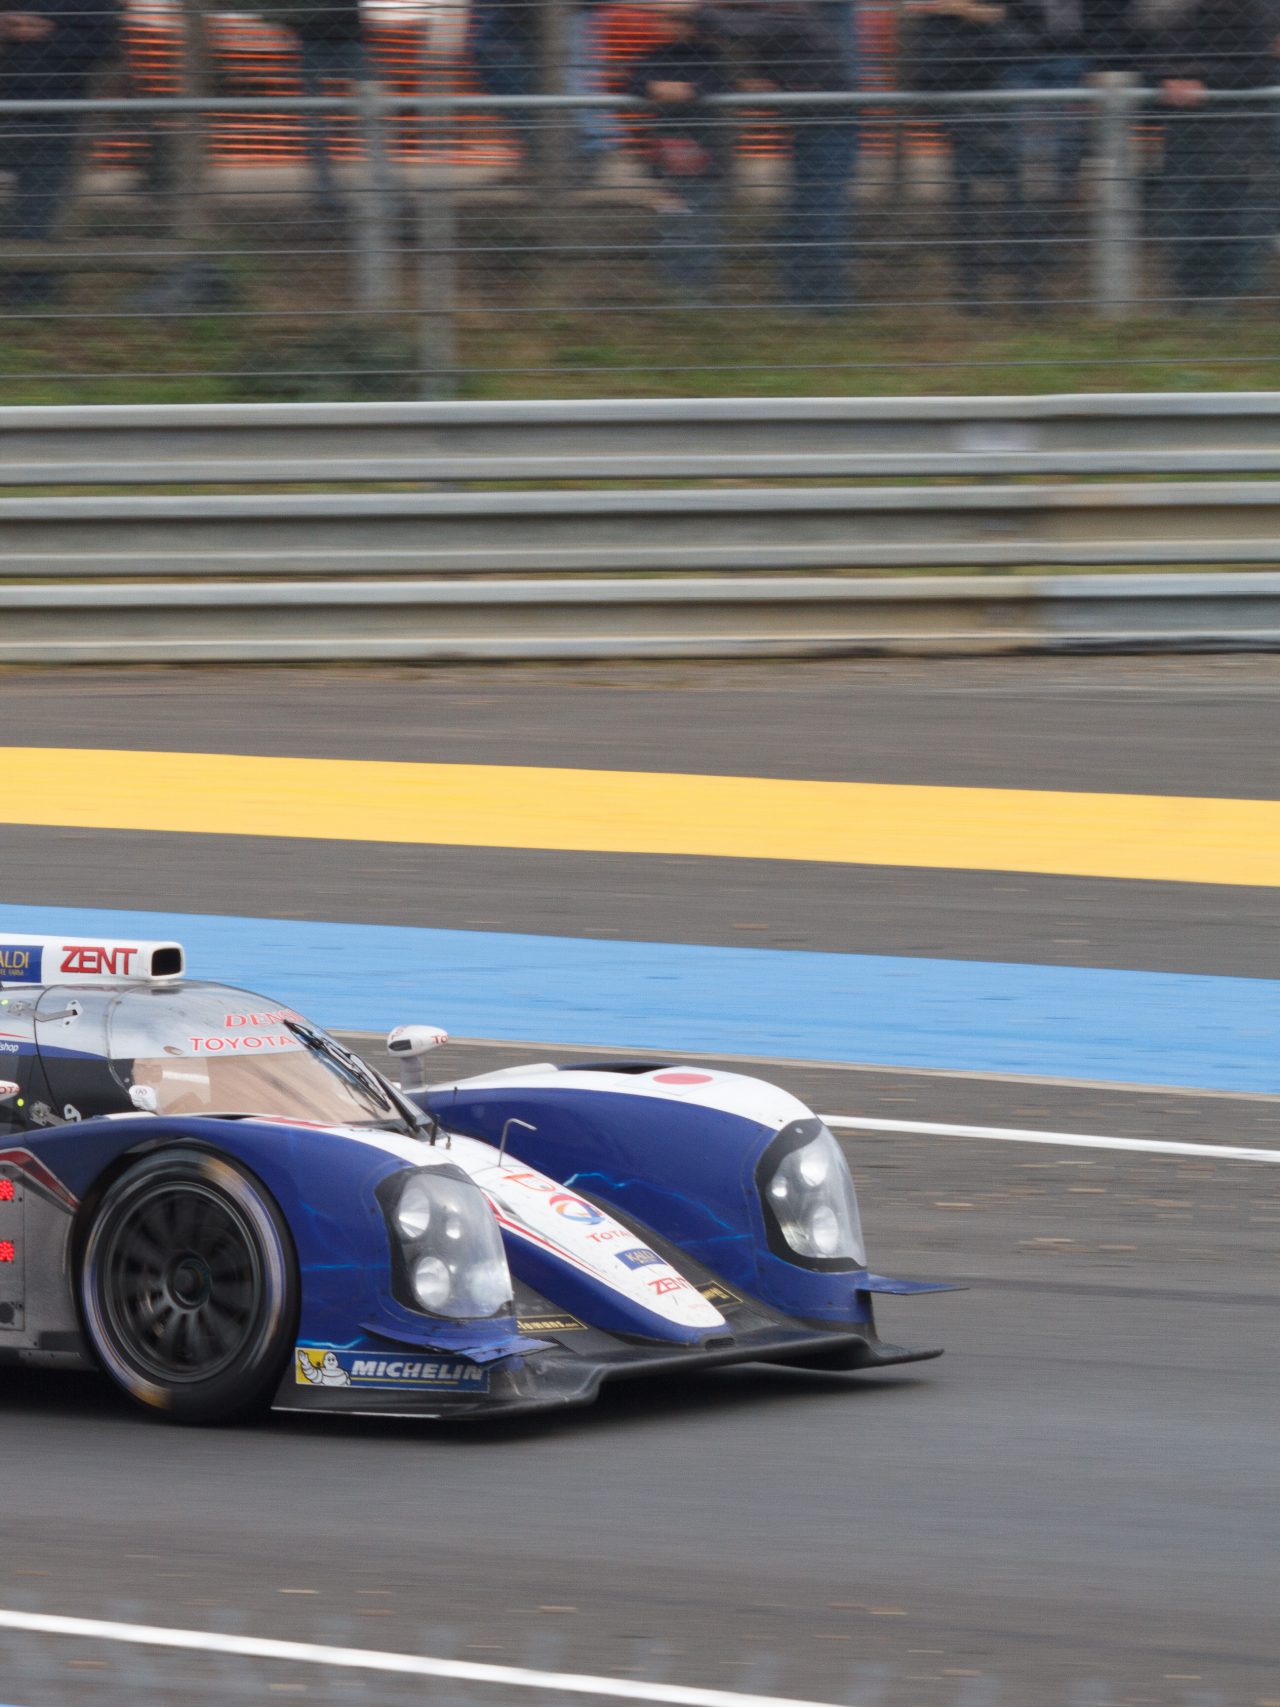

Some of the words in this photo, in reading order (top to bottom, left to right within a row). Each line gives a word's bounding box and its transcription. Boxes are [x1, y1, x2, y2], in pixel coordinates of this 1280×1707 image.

[60, 946, 138, 975] ZENT
[191, 1036, 297, 1051] TOYOTA
[351, 1360, 483, 1380] MICHELIN
